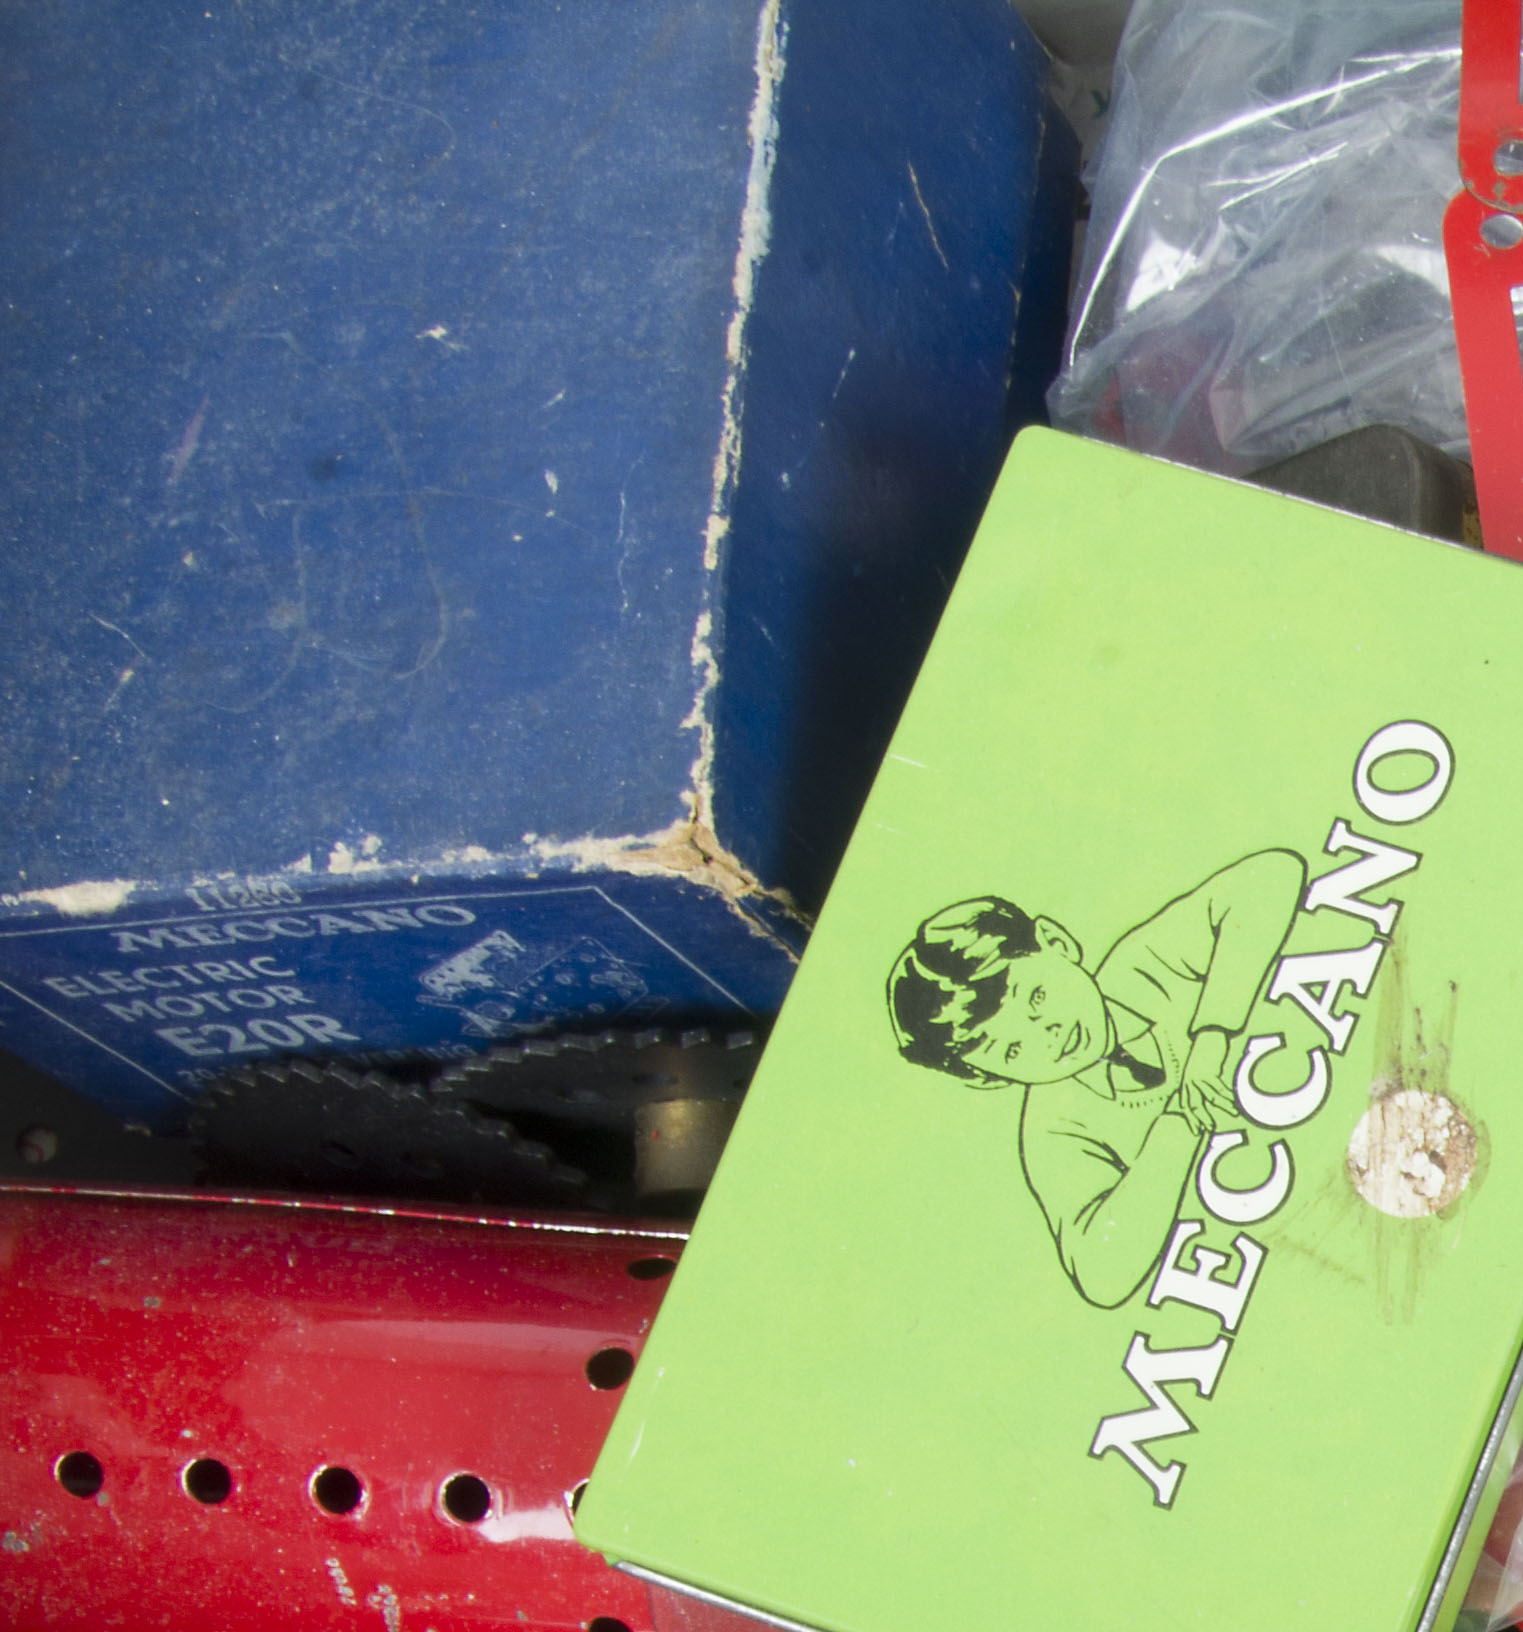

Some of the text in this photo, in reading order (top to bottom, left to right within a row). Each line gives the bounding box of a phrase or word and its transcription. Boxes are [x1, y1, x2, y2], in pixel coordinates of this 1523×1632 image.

[111, 903, 477, 954] MECCANO
[42, 955, 297, 1000] ELECTRIC
[101, 983, 315, 1024] MOTOR
[154, 1012, 364, 1058] E20R
[1087, 719, 1456, 1510] MECCANO
